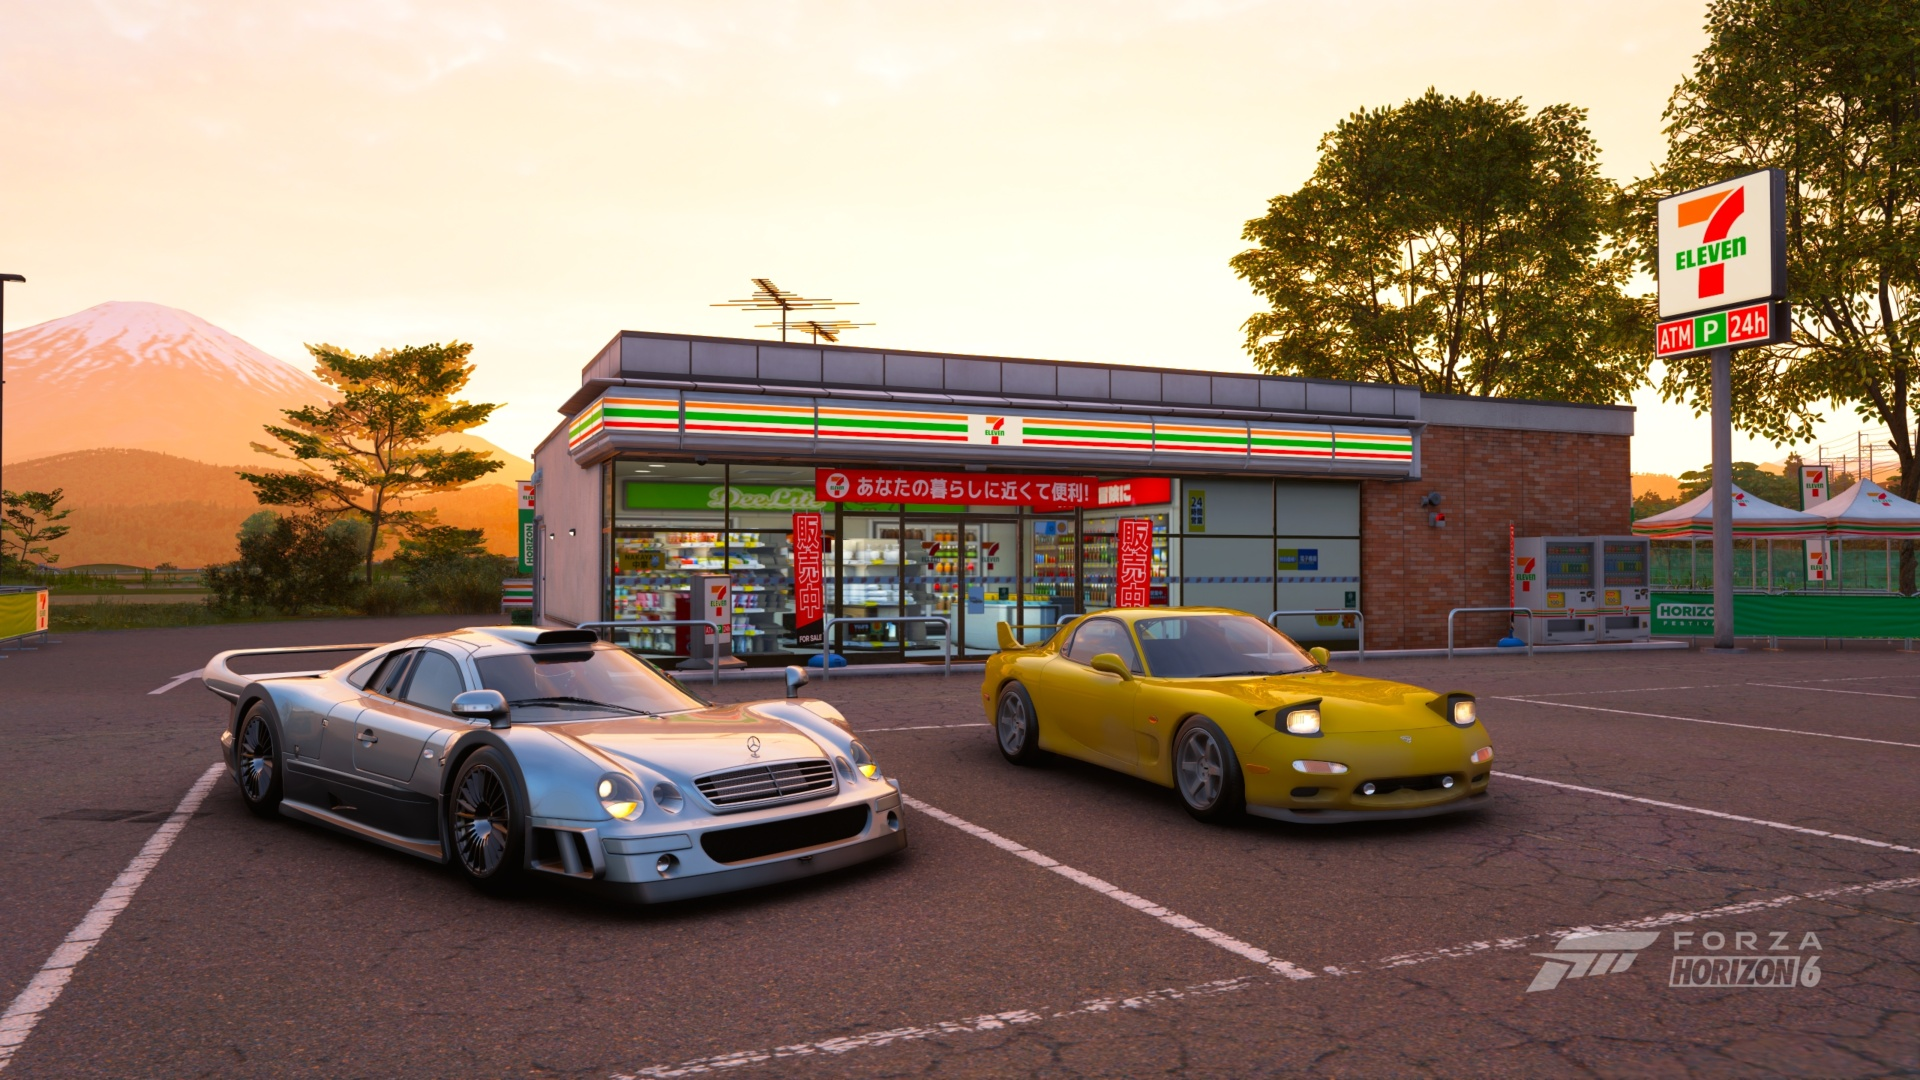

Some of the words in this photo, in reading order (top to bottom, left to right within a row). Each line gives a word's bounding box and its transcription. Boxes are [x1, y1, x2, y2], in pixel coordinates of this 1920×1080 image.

[1677, 185, 1745, 299] 7
[1660, 324, 1691, 350] ATM
[1703, 319, 1719, 343] P
[1730, 310, 1766, 338] 24h
[985, 416, 1005, 445] 7
[797, 515, 821, 619] 販売中
[1660, 605, 1714, 617] HORIZO
[799, 635, 811, 643] FOR
[811, 633, 823, 642] SALE
